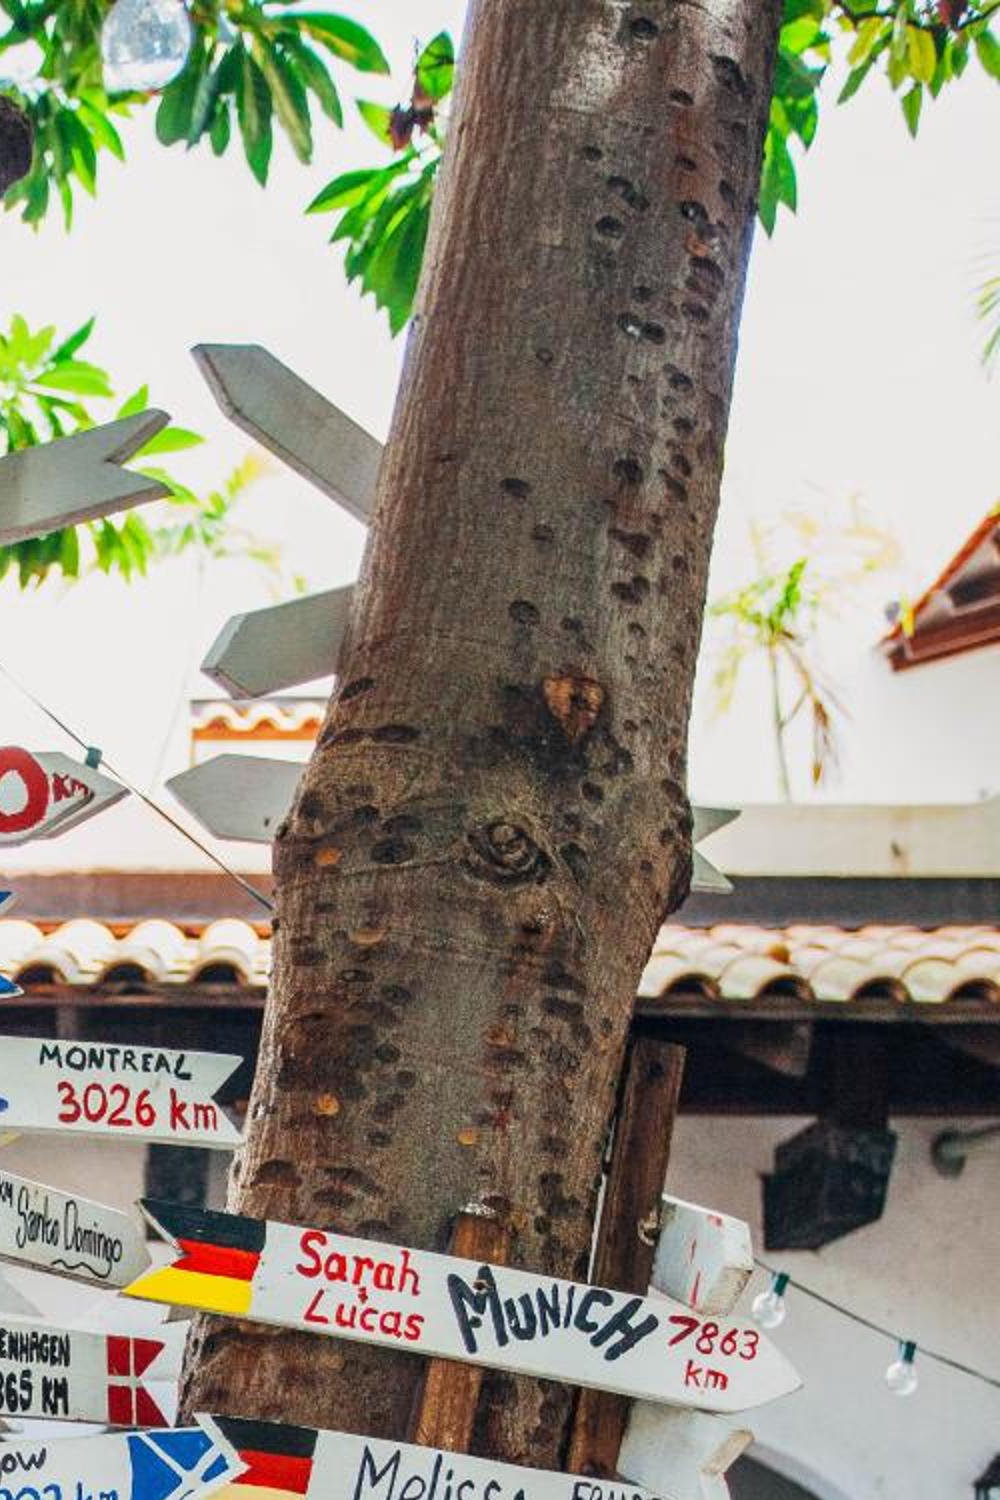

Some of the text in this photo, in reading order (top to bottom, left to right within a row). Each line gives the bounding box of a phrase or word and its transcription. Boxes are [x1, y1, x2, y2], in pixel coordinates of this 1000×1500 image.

[39, 1043, 193, 1081] MONTREAL
[57, 1081, 219, 1132] 3026 km
[16, 1186, 60, 1249] Santo
[63, 1200, 123, 1278] Domingo
[296, 1230, 421, 1297] Sarah
[668, 1314, 761, 1361] 7863
[303, 1288, 729, 1391] Lucas km
[41, 1375, 69, 1416] KM
